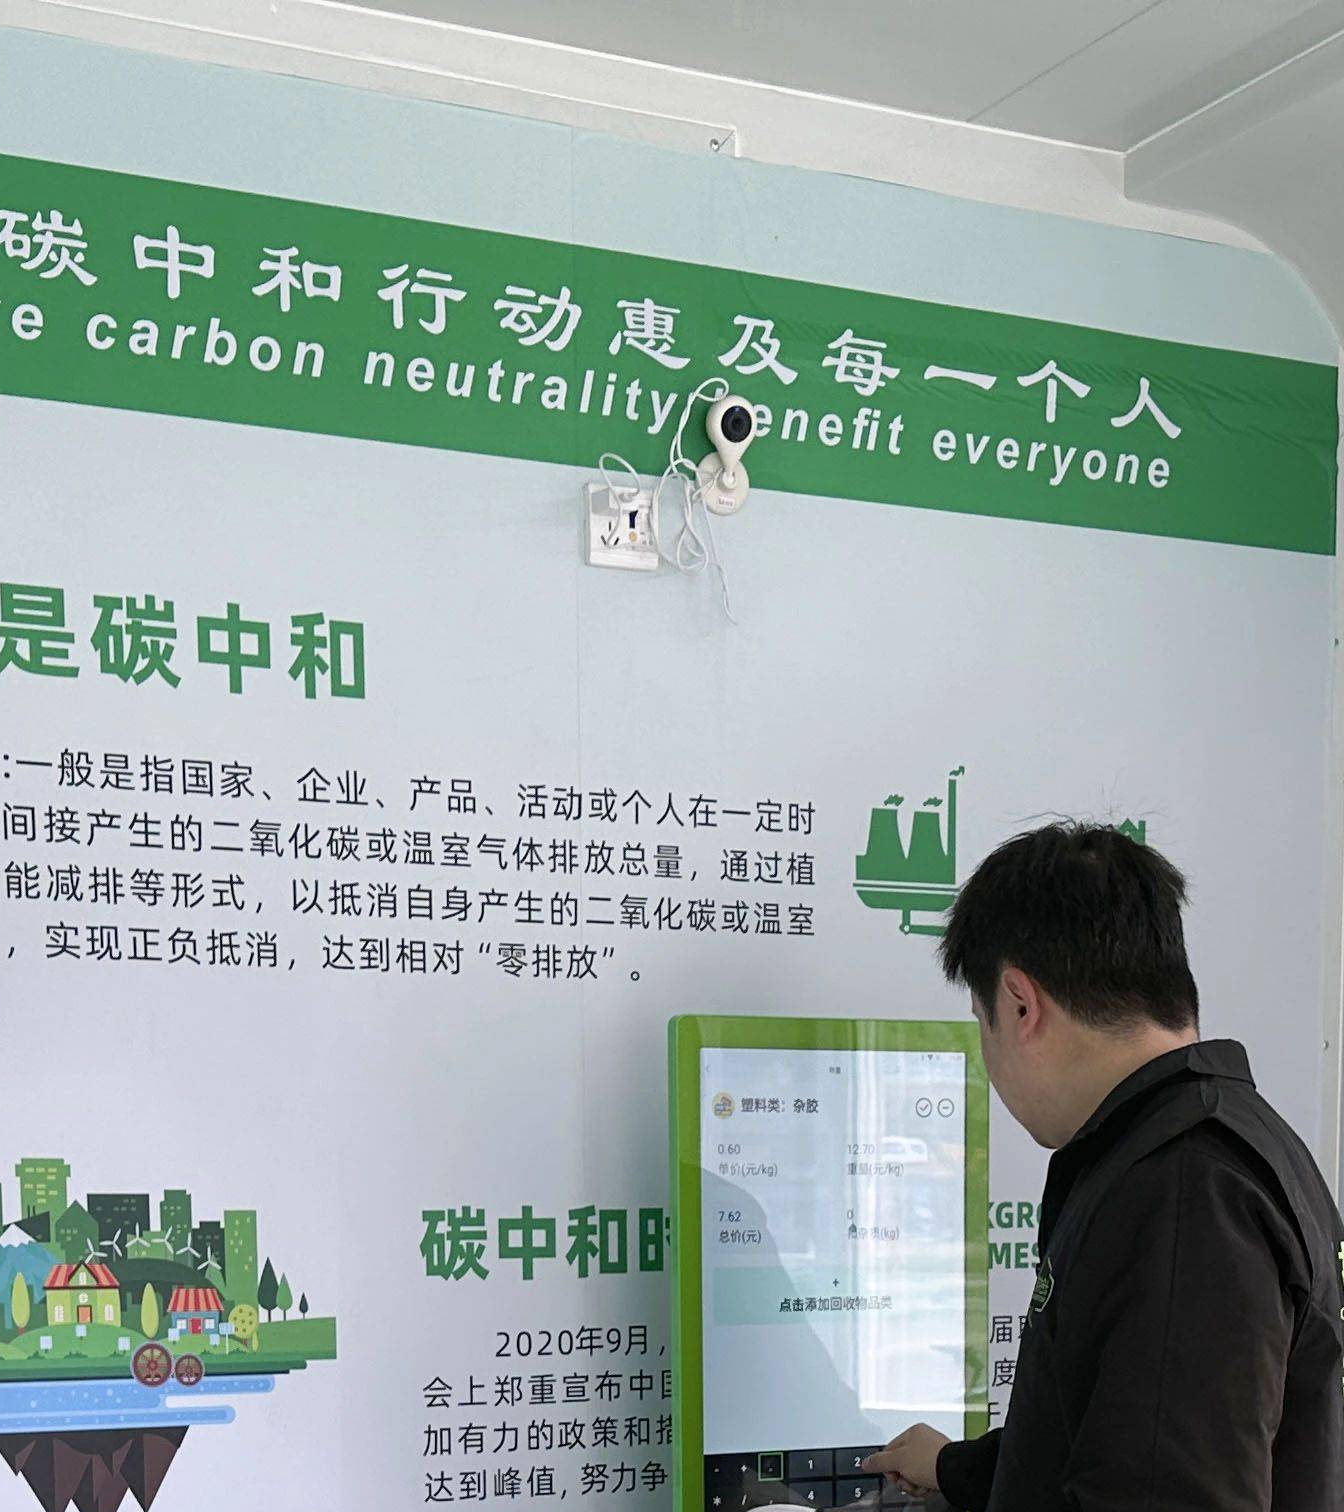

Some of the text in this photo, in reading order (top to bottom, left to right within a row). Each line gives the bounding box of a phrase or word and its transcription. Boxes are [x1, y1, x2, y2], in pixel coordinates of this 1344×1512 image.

[85, 310, 327, 379] carbon
[362, 348, 678, 437] neutrality
[712, 386, 905, 457] enefit
[930, 426, 1172, 490] everyone
[718, 1211, 742, 1223] 7.62
[989, 1315, 1029, 1345] 届
[424, 1460, 669, 1503] 达到峰值，努力争
